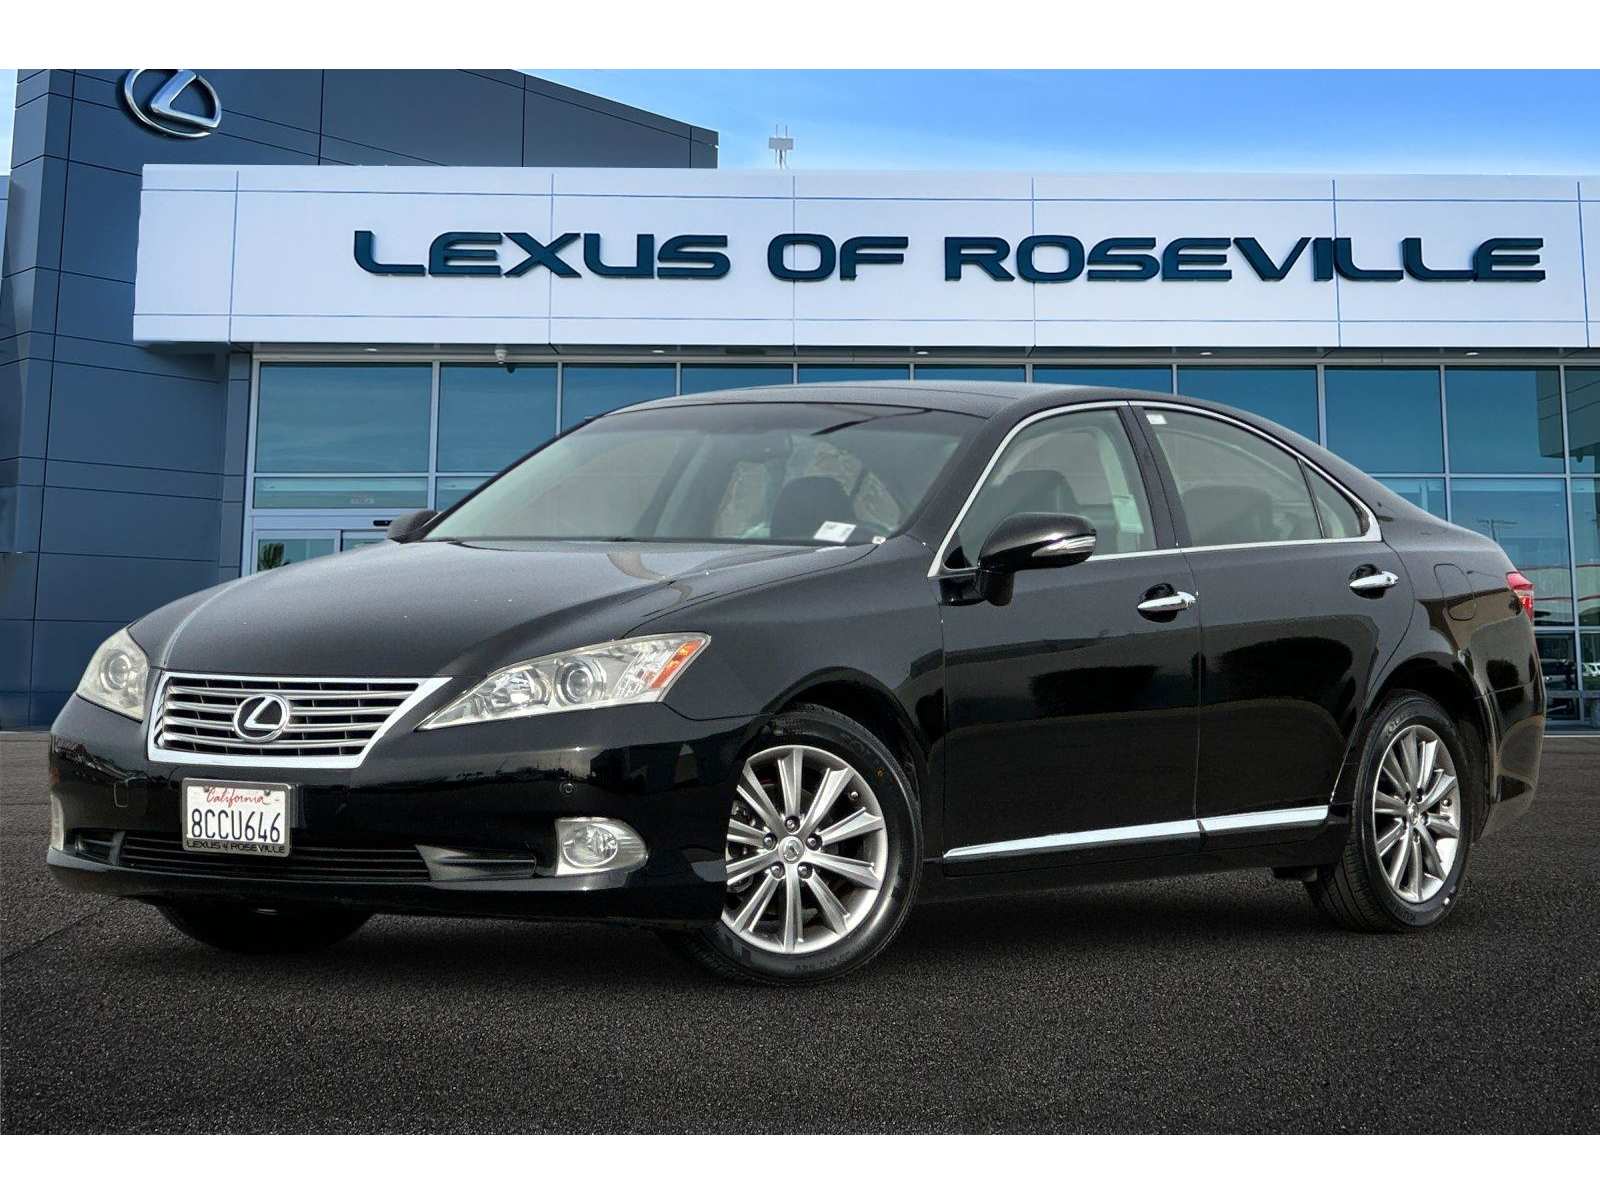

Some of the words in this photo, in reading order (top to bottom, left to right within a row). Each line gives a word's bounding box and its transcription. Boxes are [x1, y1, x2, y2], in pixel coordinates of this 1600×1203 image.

[354, 231, 730, 281] LEXUS
[767, 234, 909, 281] OF
[944, 235, 1546, 282] ROSEVILLE
[207, 785, 270, 808] California
[191, 808, 281, 843] 8CCU646
[187, 840, 221, 850] LEXUS
